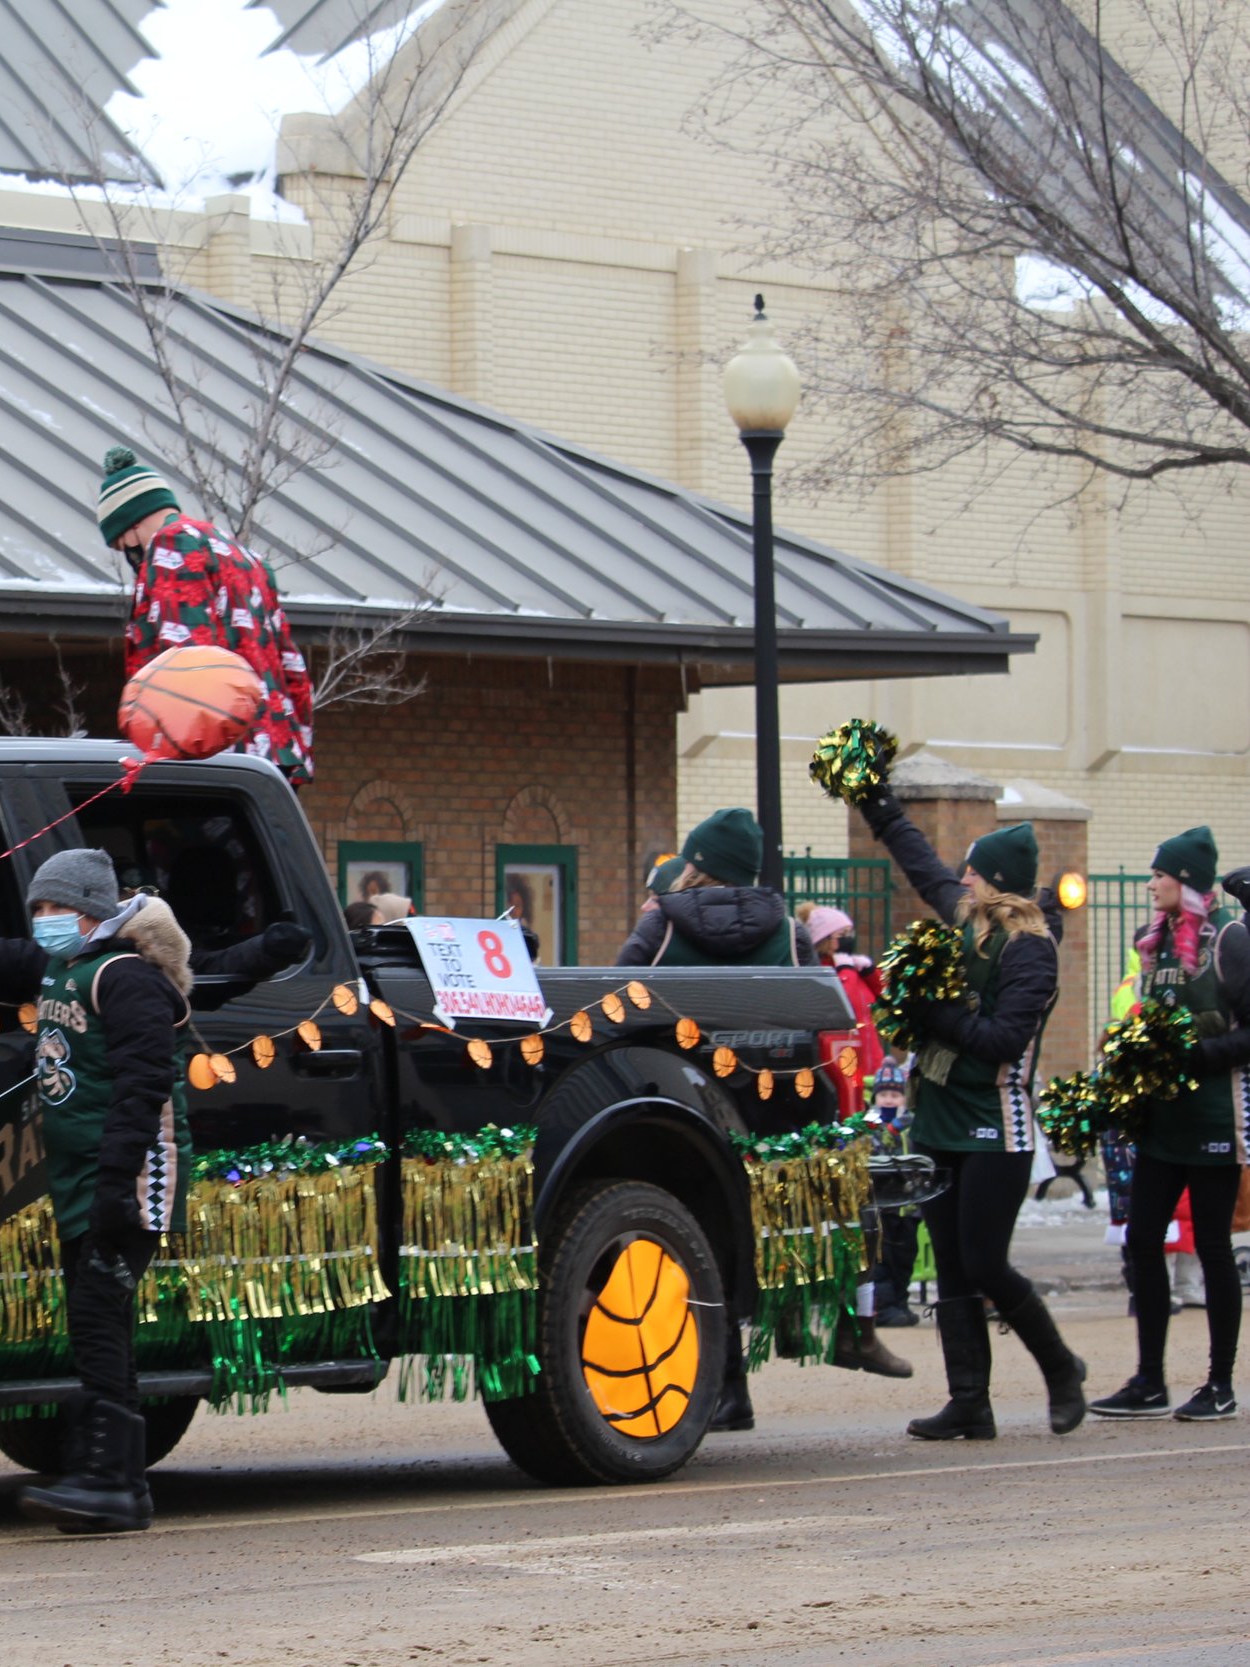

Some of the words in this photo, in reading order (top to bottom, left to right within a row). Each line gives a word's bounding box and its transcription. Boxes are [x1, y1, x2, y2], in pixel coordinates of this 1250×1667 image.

[427, 943, 461, 956] TEXT
[477, 930, 512, 978] 8
[440, 958, 461, 971] TO
[438, 973, 476, 987] VOTE
[710, 1029, 807, 1048] SPORT
